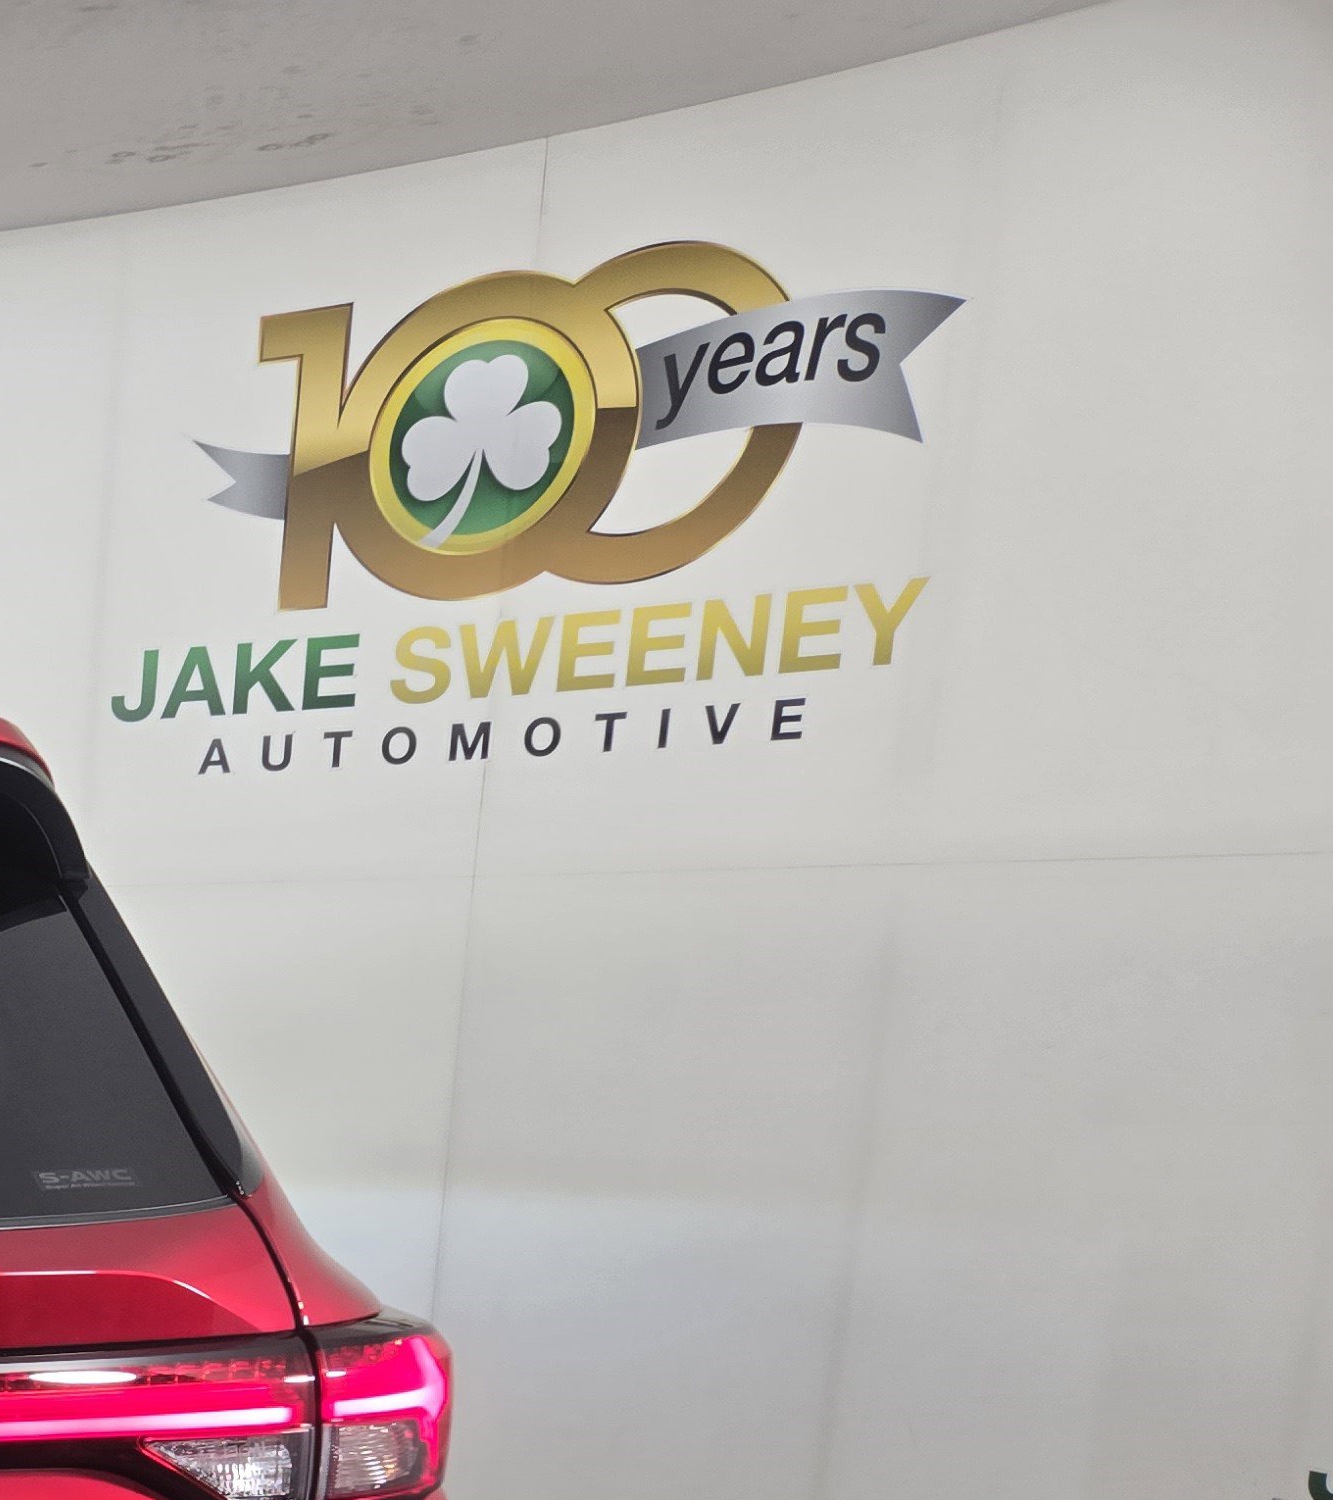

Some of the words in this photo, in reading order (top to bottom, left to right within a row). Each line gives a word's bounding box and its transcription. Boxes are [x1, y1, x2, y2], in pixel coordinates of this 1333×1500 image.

[258, 240, 805, 612] 100
[654, 310, 887, 431] years
[110, 633, 361, 724] JAKE
[390, 577, 931, 706] SWEENEY
[197, 697, 808, 777] AUTOMOTIVE
[38, 1169, 132, 1184] S-AWC
